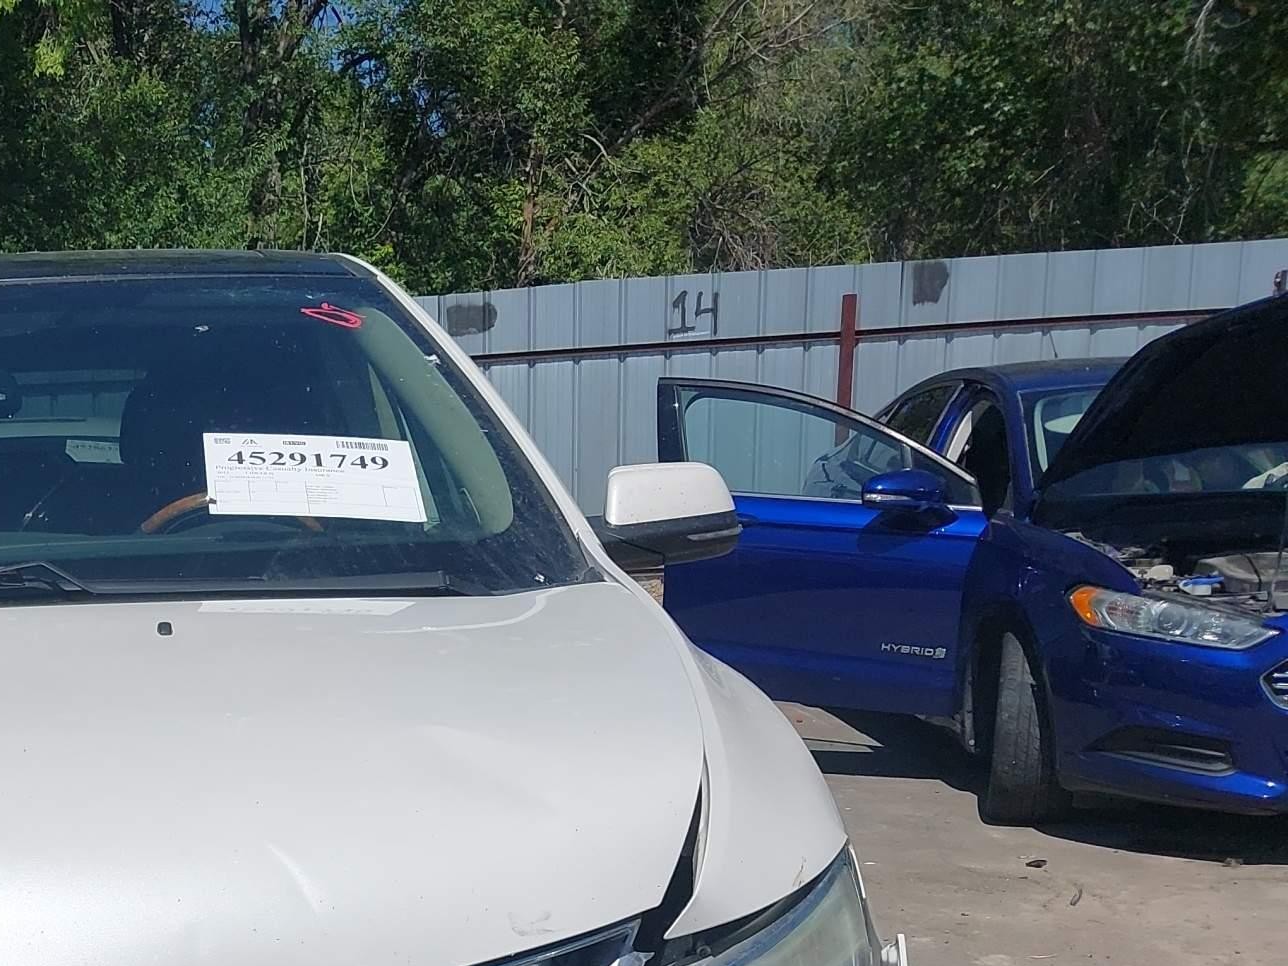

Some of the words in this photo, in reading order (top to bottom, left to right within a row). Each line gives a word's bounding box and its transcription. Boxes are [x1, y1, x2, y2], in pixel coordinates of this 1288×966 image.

[668, 290, 719, 336] 14
[228, 450, 390, 471] 45291749
[881, 642, 934, 657] HYBRID
